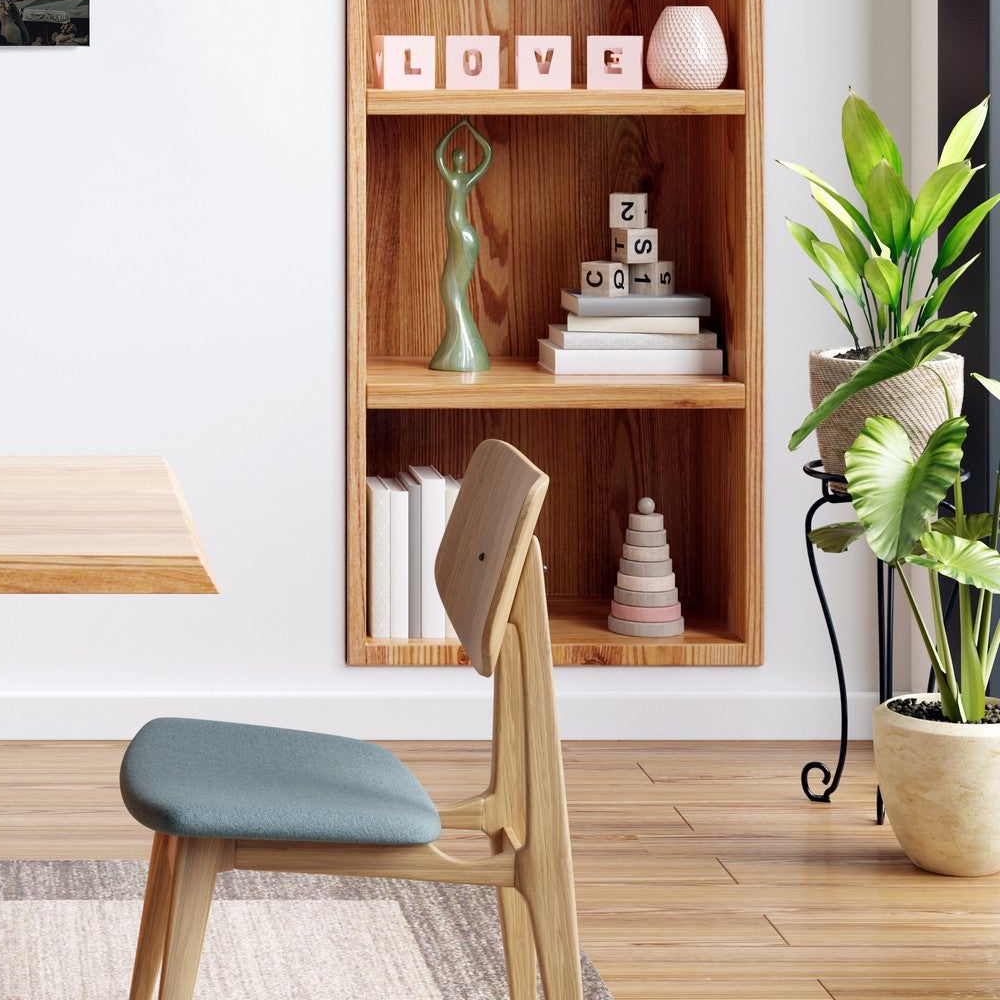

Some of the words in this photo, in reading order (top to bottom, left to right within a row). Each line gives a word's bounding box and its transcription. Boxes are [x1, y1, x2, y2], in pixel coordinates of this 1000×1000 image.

[404, 48, 623, 75] LOVE
[621, 202, 635, 221] 2
[634, 239, 652, 254] S
[586, 270, 603, 287] C
[614, 269, 625, 290] Q
